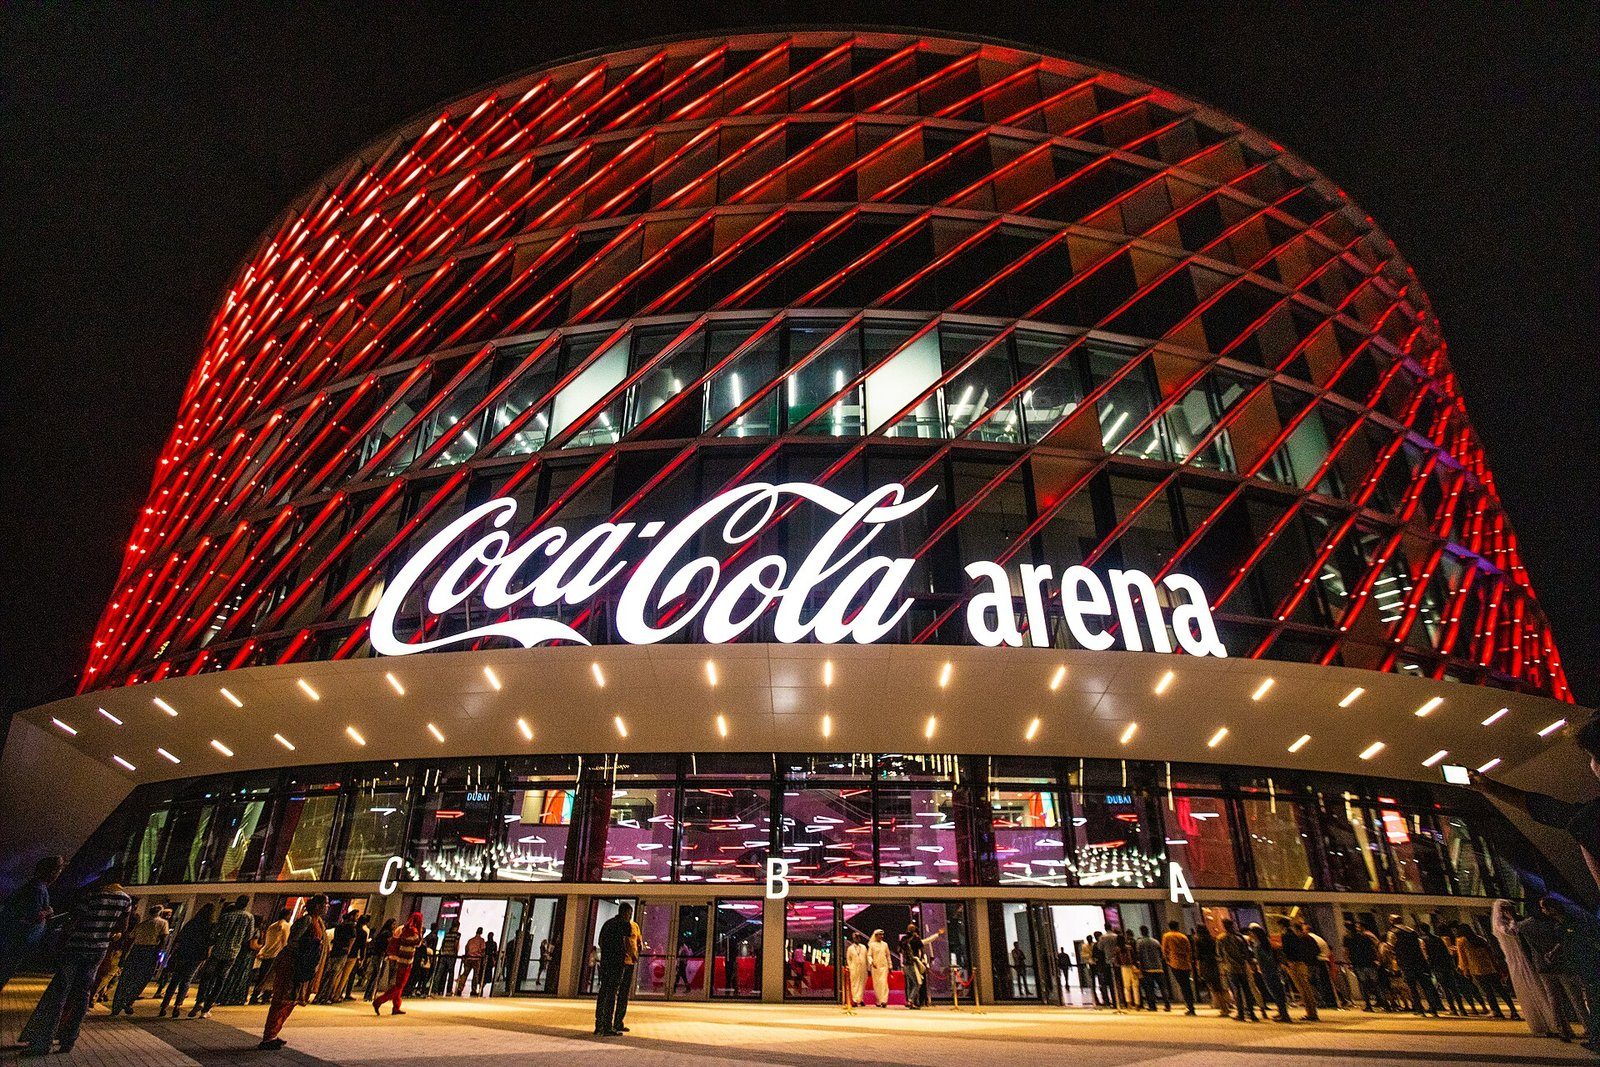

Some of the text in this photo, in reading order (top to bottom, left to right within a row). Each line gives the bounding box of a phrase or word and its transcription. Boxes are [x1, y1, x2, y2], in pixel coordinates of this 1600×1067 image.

[369, 482, 1228, 658] Coca-Cola arena
[466, 792, 490, 802] DUBAI
[1106, 795, 1132, 804] DUBAI
[379, 855, 403, 895] C
[766, 857, 789, 899] B
[1169, 861, 1195, 903] A
